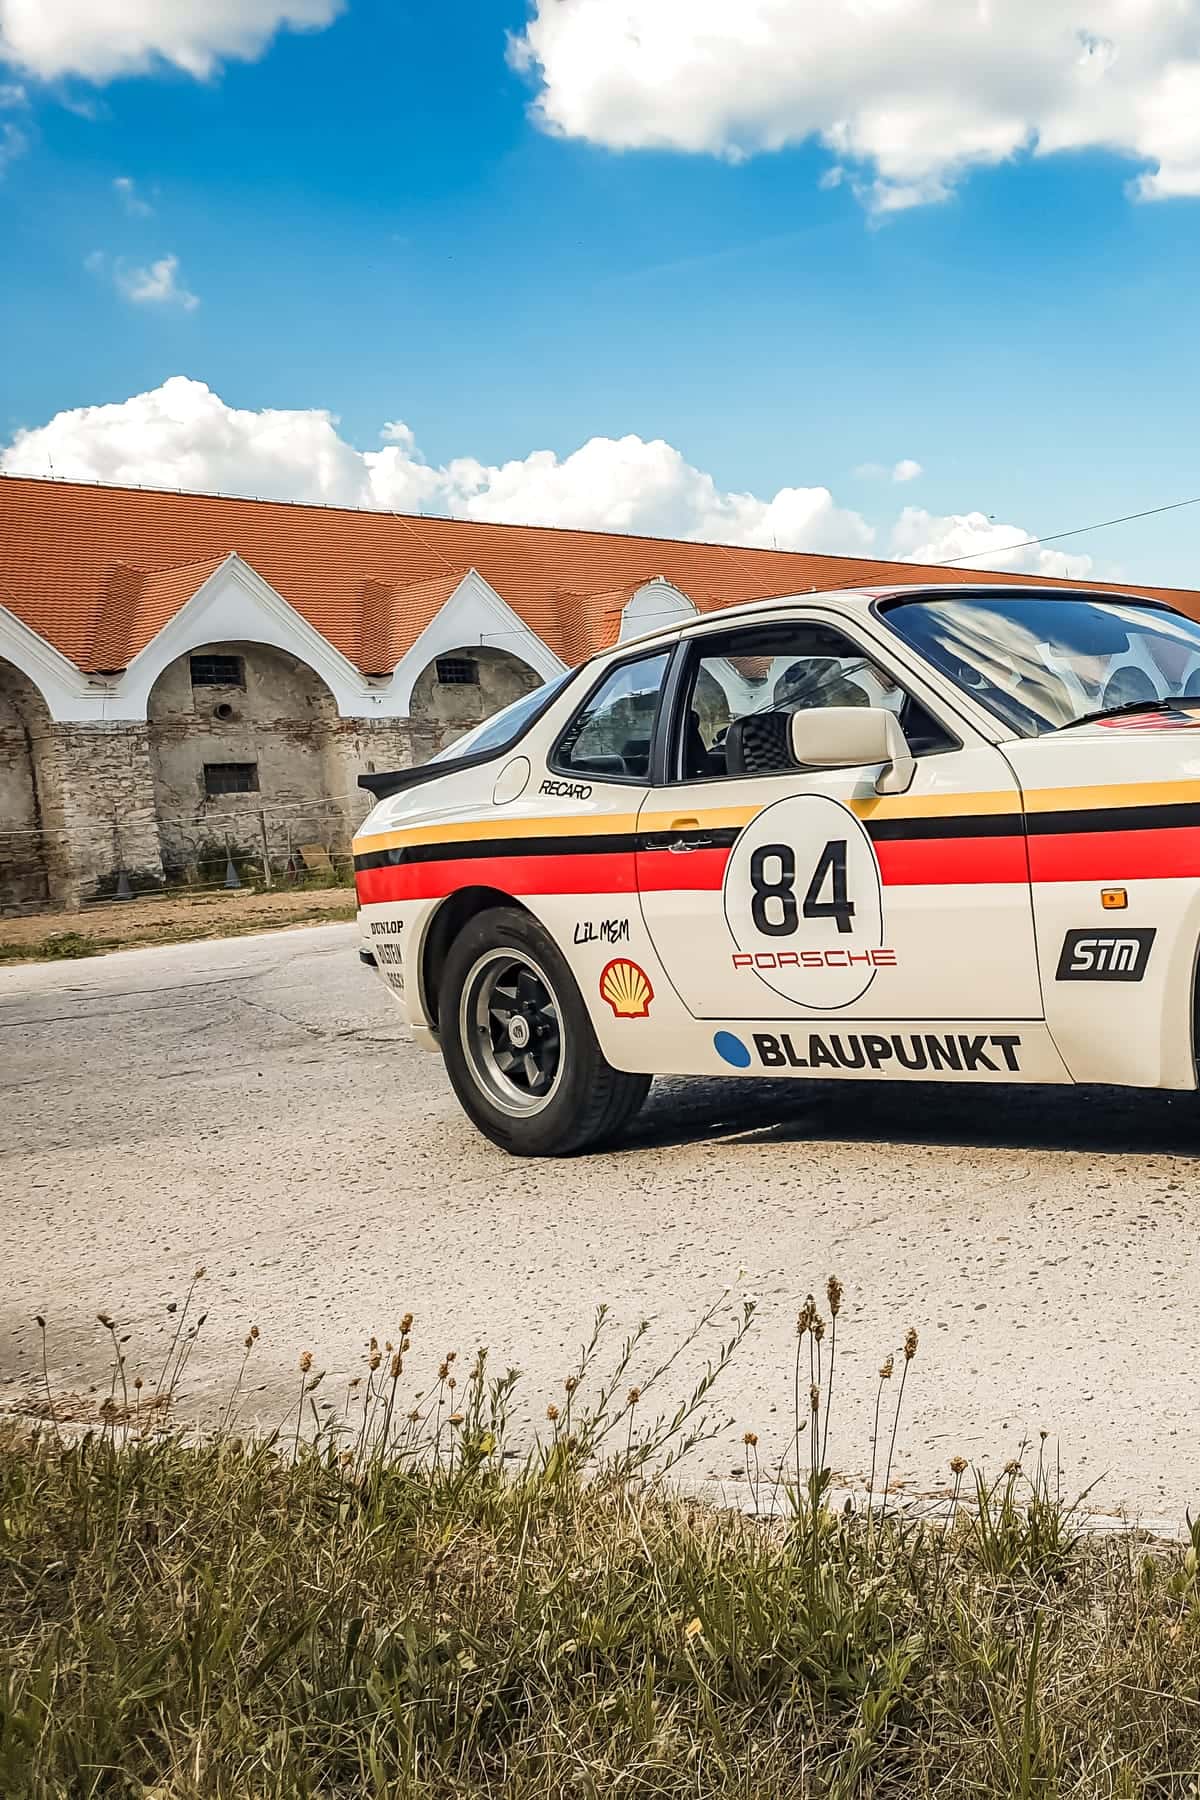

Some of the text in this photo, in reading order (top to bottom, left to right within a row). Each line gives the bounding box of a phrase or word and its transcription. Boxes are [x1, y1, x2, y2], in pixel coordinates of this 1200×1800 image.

[538, 780, 593, 800] RECARO
[750, 840, 856, 937] 84
[370, 920, 404, 935] DUNLOP
[732, 949, 898, 970] PORSCHE
[752, 1033, 1022, 1072] BLAUPUNKT
